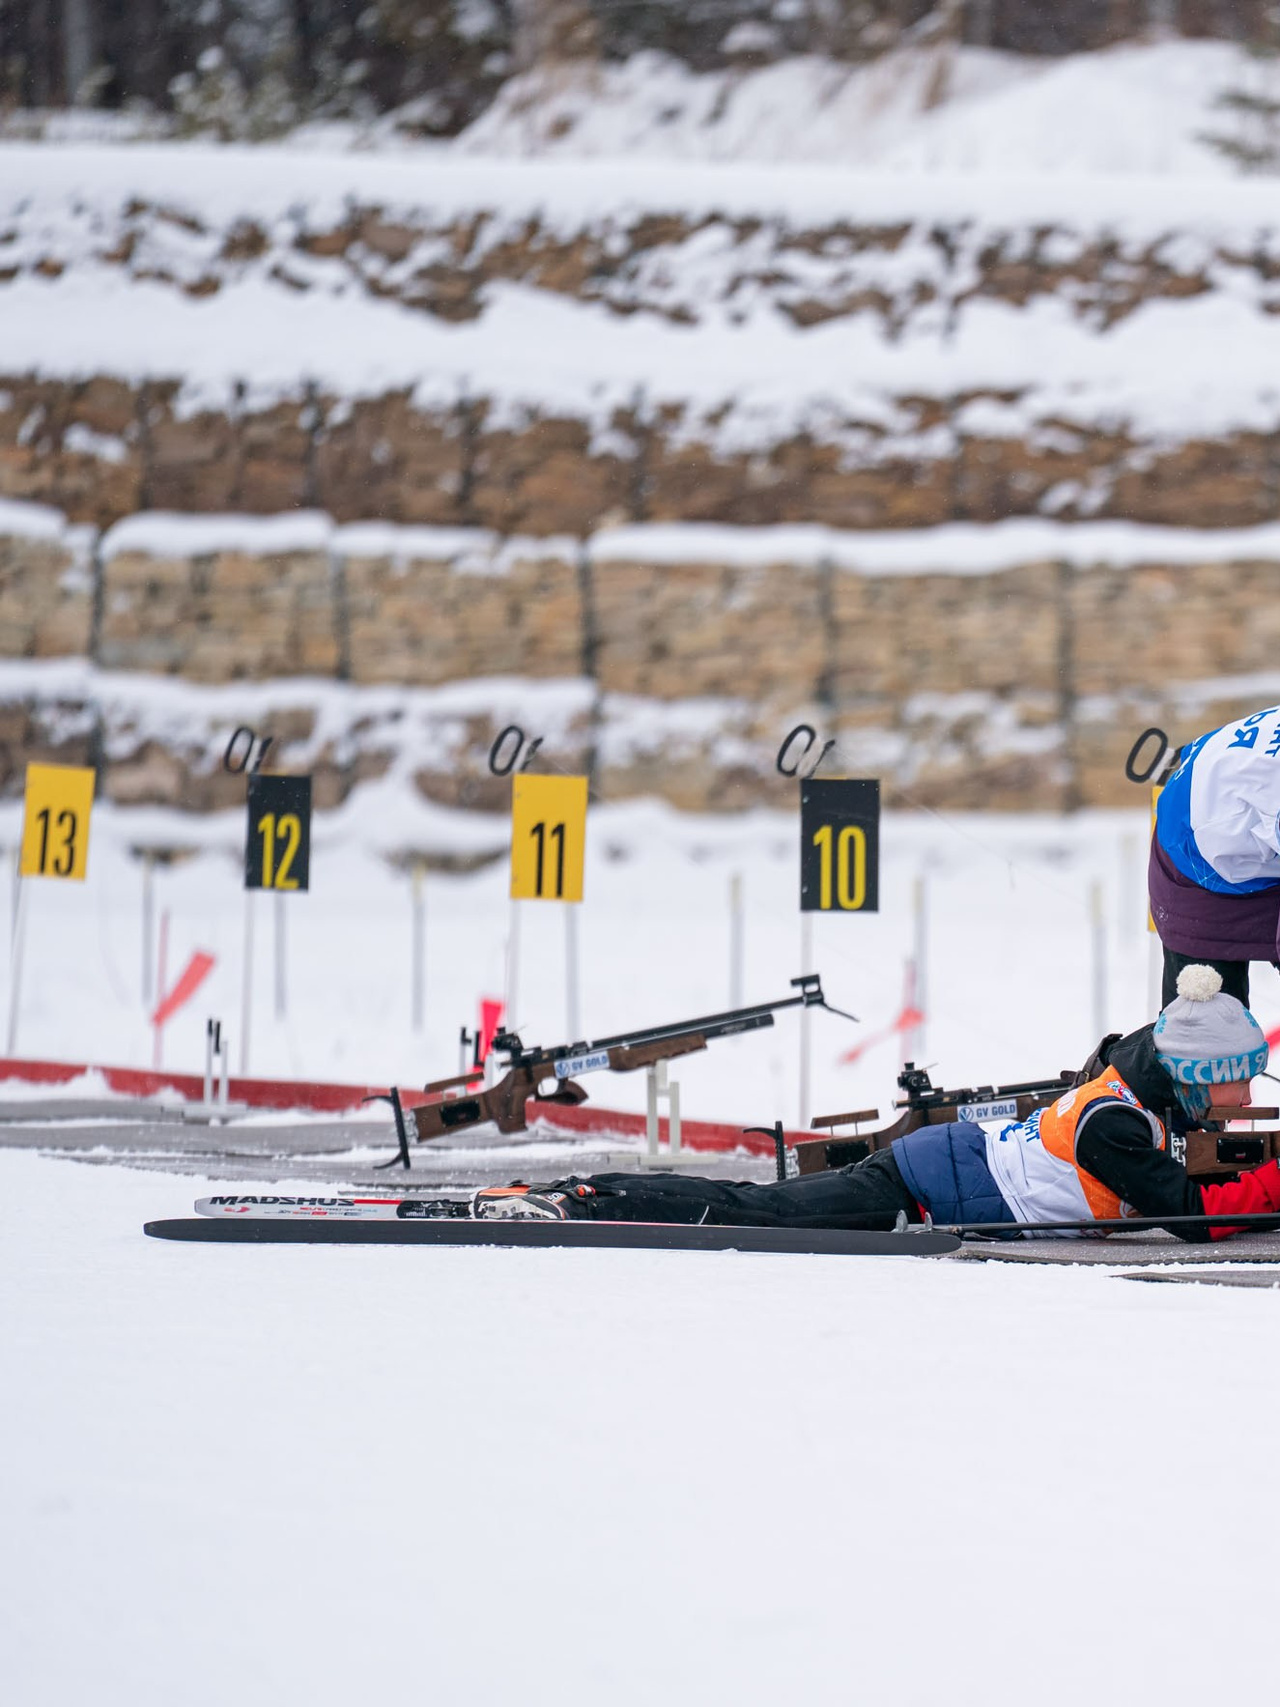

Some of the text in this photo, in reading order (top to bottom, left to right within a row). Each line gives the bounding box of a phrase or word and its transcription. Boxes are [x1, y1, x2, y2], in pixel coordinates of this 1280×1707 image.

[36, 807, 78, 877] 13
[257, 812, 302, 890] 12
[529, 822, 566, 898] 11
[812, 824, 867, 911] 10
[1160, 1054, 1251, 1085] ОССИИ
[976, 1104, 1016, 1118] GV GOLD
[209, 1195, 355, 1207] MADSHUS
